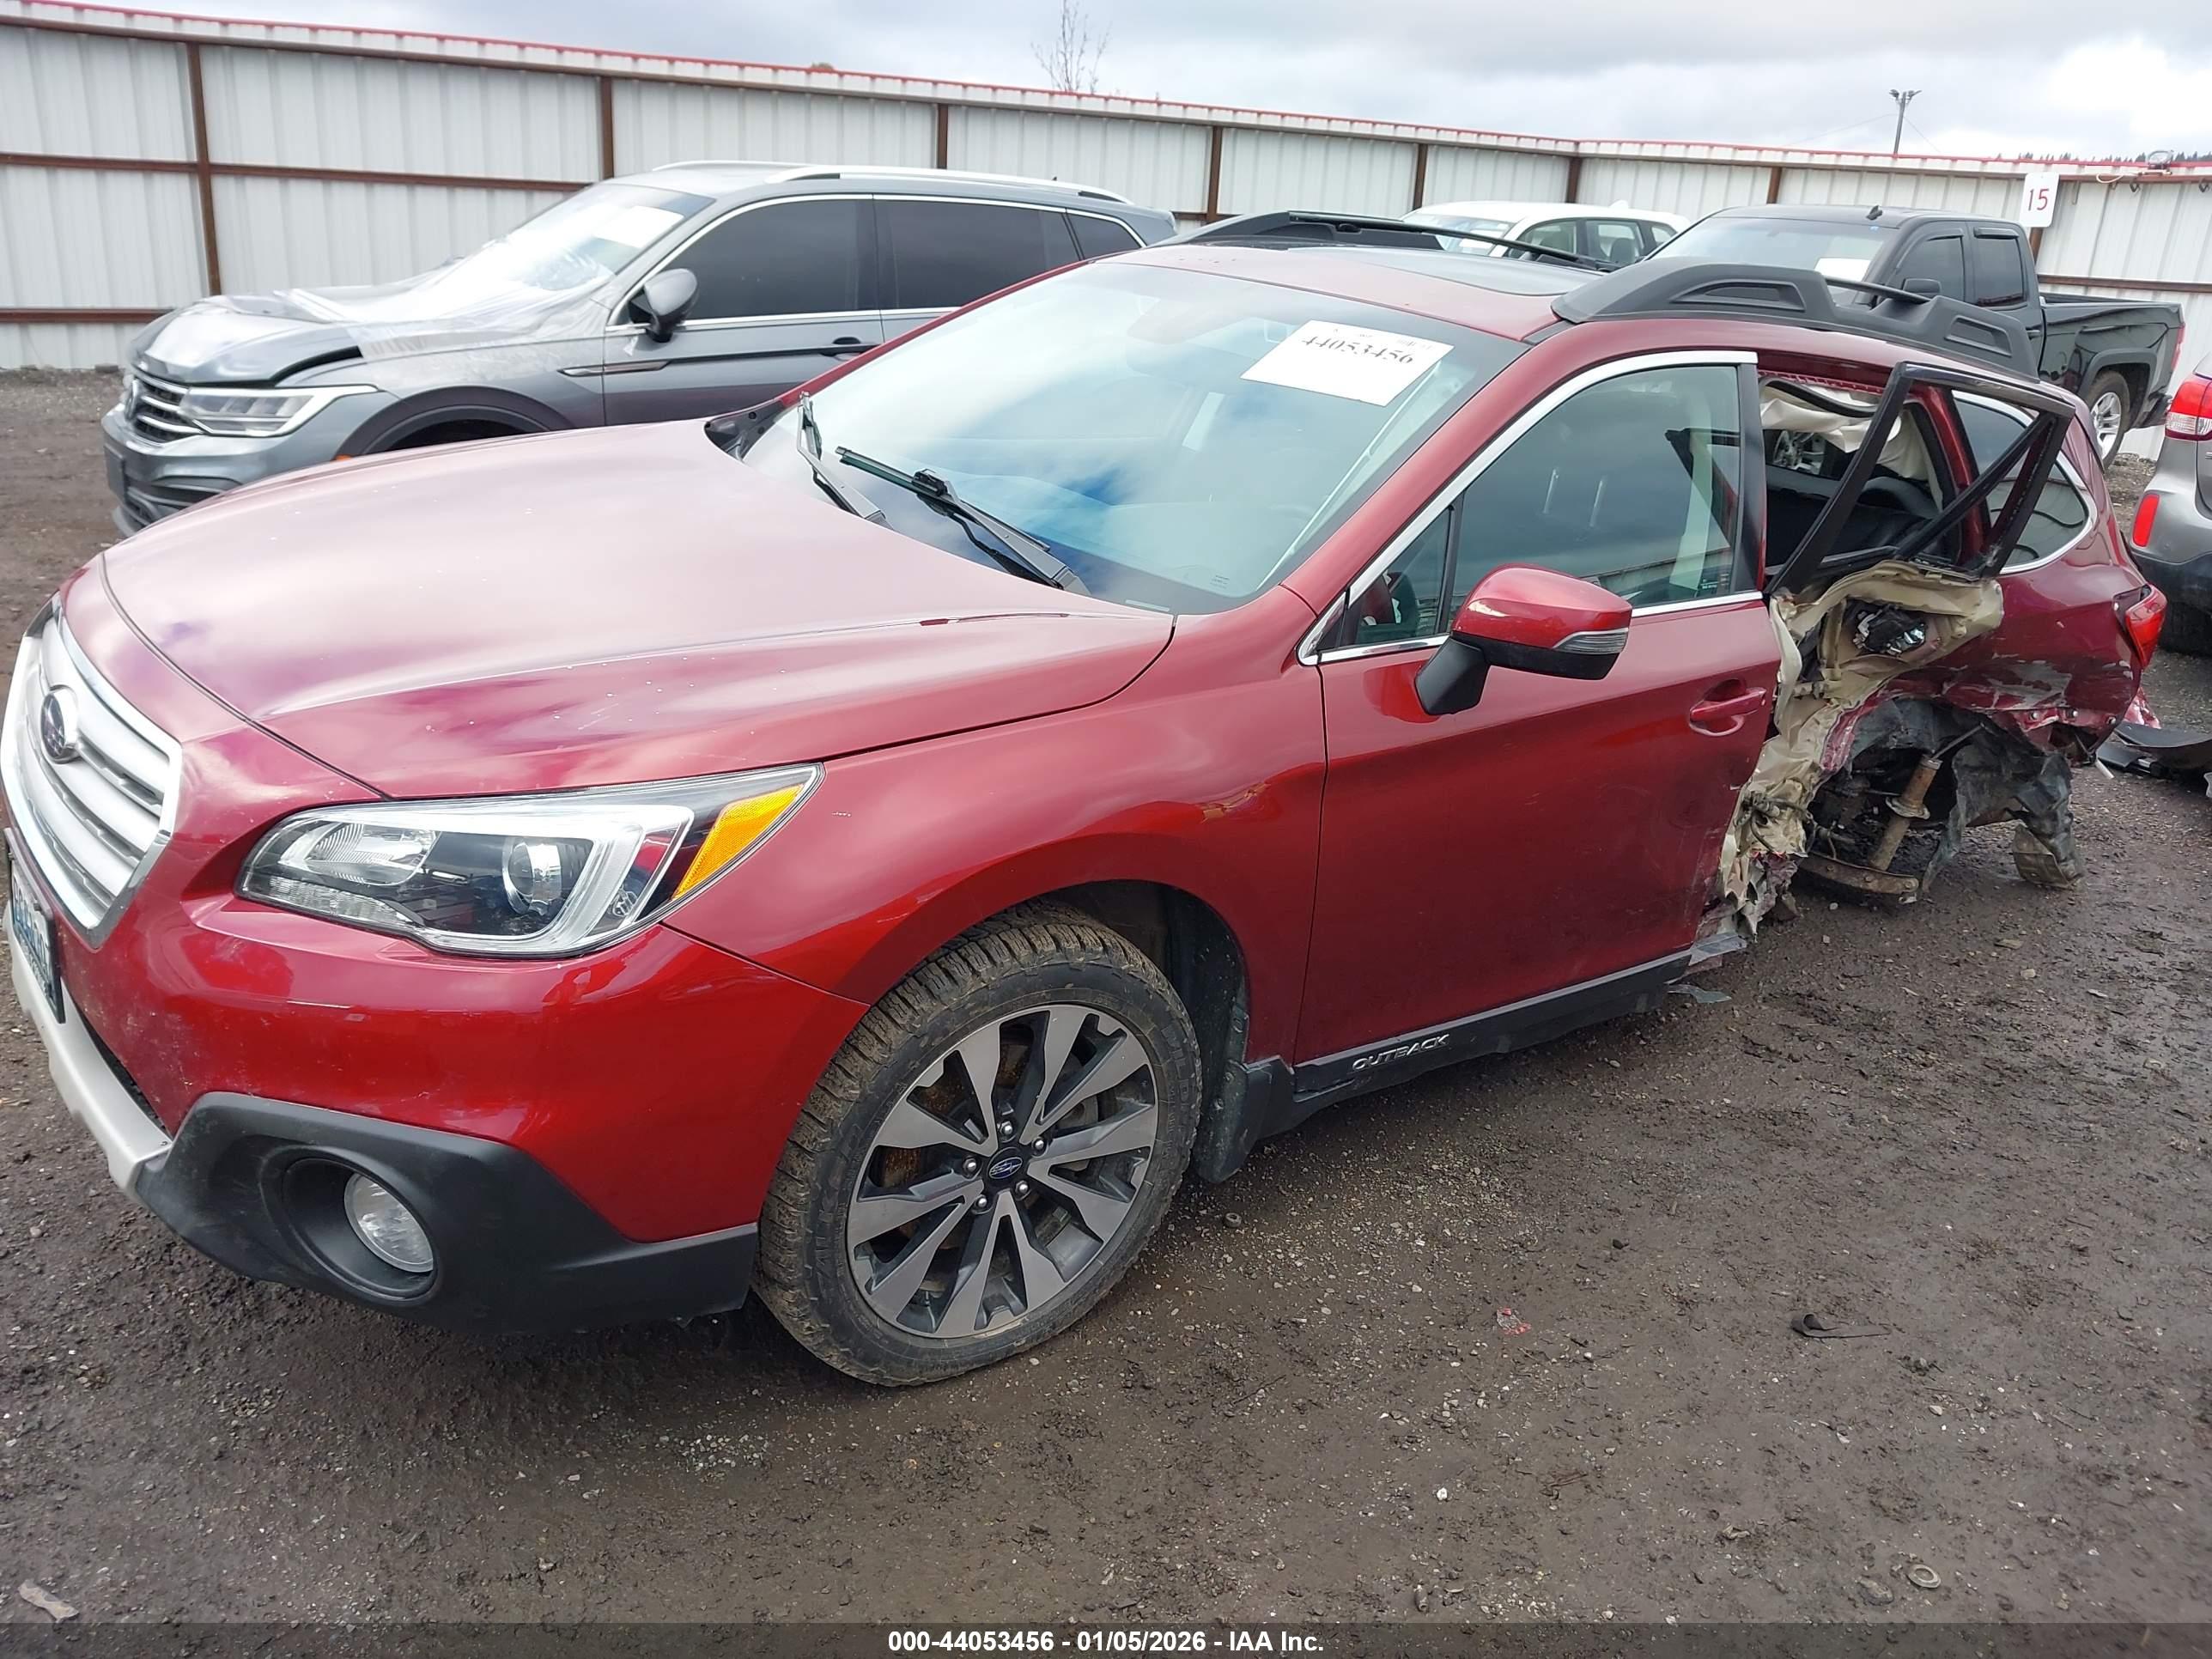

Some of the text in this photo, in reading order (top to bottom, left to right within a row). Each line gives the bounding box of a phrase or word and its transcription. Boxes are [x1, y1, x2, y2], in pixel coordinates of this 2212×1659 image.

[2027, 188, 2050, 211] 15
[1301, 336, 1414, 364] 44053456
[1352, 1033, 1450, 1071] OUTBACK
